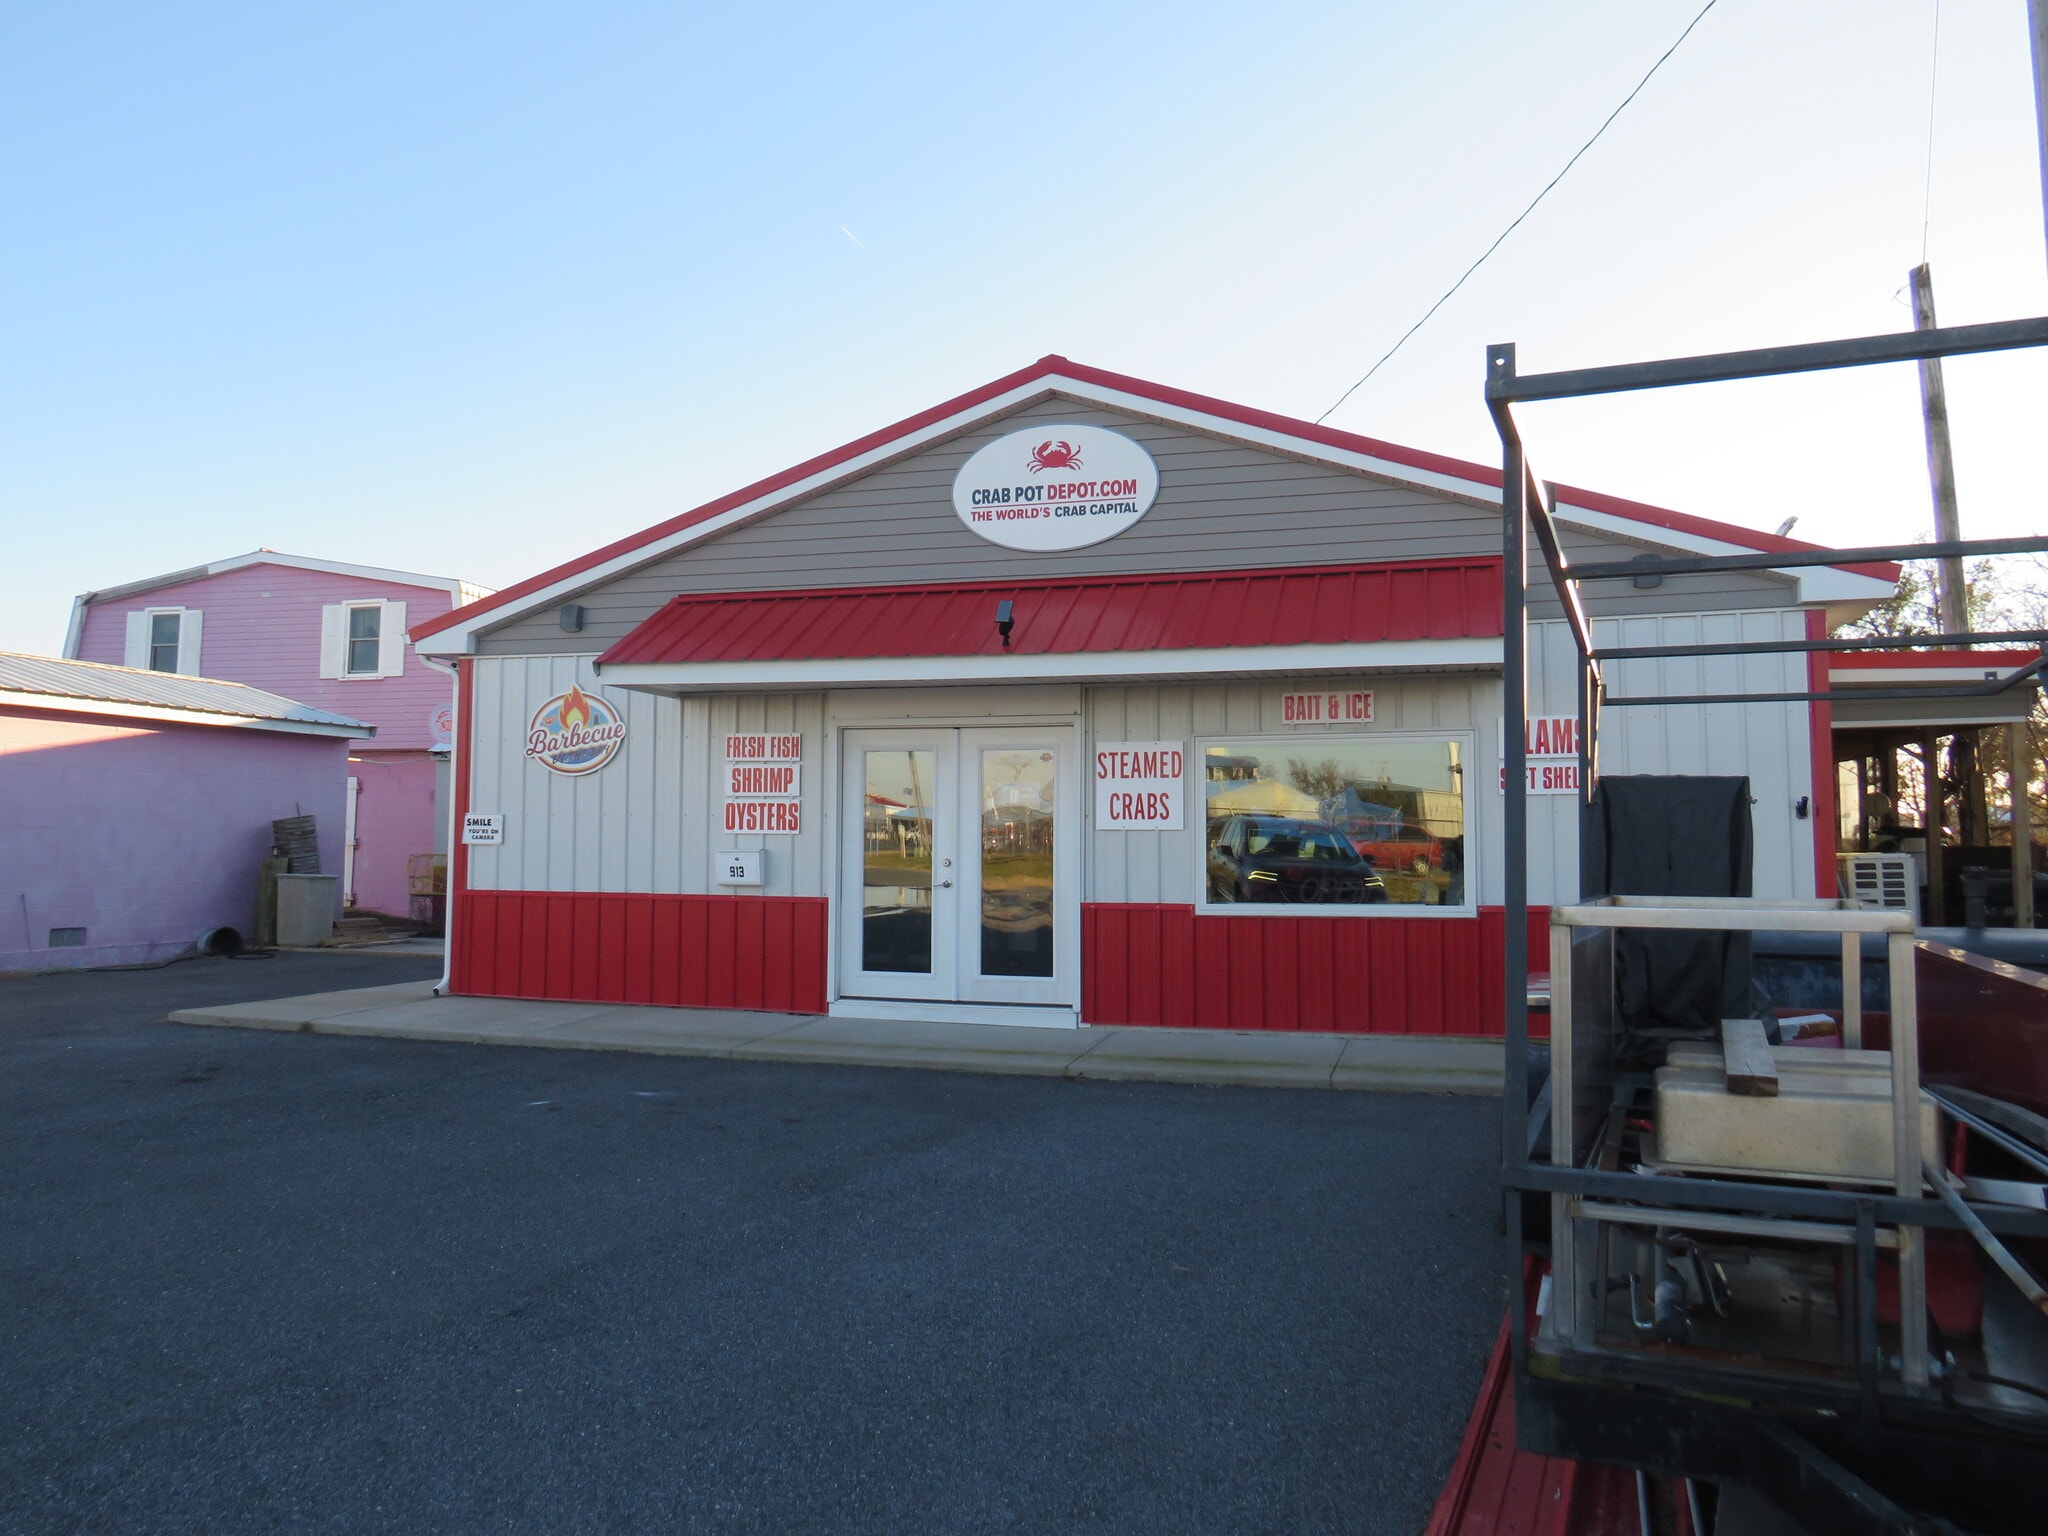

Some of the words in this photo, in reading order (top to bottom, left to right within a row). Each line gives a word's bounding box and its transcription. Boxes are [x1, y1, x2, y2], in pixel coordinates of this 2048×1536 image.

[972, 487, 1011, 505] CRAB
[1015, 485, 1044, 502] POT
[1047, 479, 1137, 500] DEPOT.COM
[971, 511, 993, 522] THE
[996, 507, 1051, 520] WORLD'S
[1055, 505, 1087, 517] CRAB
[1090, 502, 1139, 515] CAPITAL
[1284, 695, 1321, 720] BAIT
[1327, 694, 1340, 719] &
[1345, 693, 1372, 719] ICE
[526, 722, 624, 756] Barbecue
[726, 736, 766, 758] FRESH
[770, 736, 800, 758] FISH
[1525, 718, 1580, 754] LAM
[1097, 751, 1183, 779] STEAMED
[732, 767, 794, 793] SHRIMP
[725, 802, 799, 831] OYSTERS
[1109, 792, 1170, 820] CRABS
[466, 818, 492, 826] SMILE
[729, 866, 745, 878] 913
